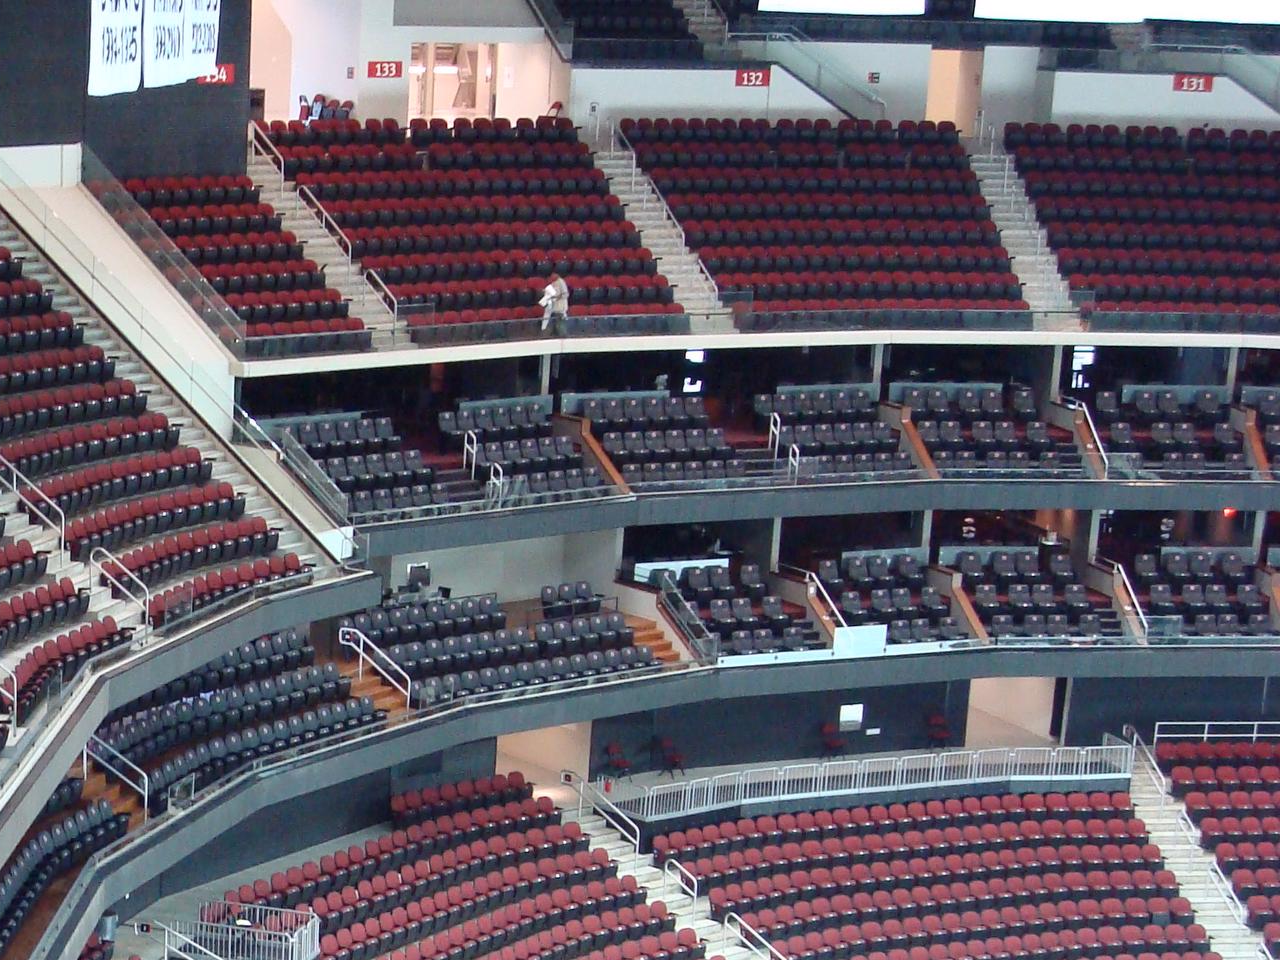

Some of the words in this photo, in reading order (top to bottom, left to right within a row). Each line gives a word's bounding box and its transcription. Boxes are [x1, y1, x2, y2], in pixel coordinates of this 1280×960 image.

[375, 62, 396, 77] 133
[742, 72, 763, 85] 132
[1182, 78, 1205, 91] 131
